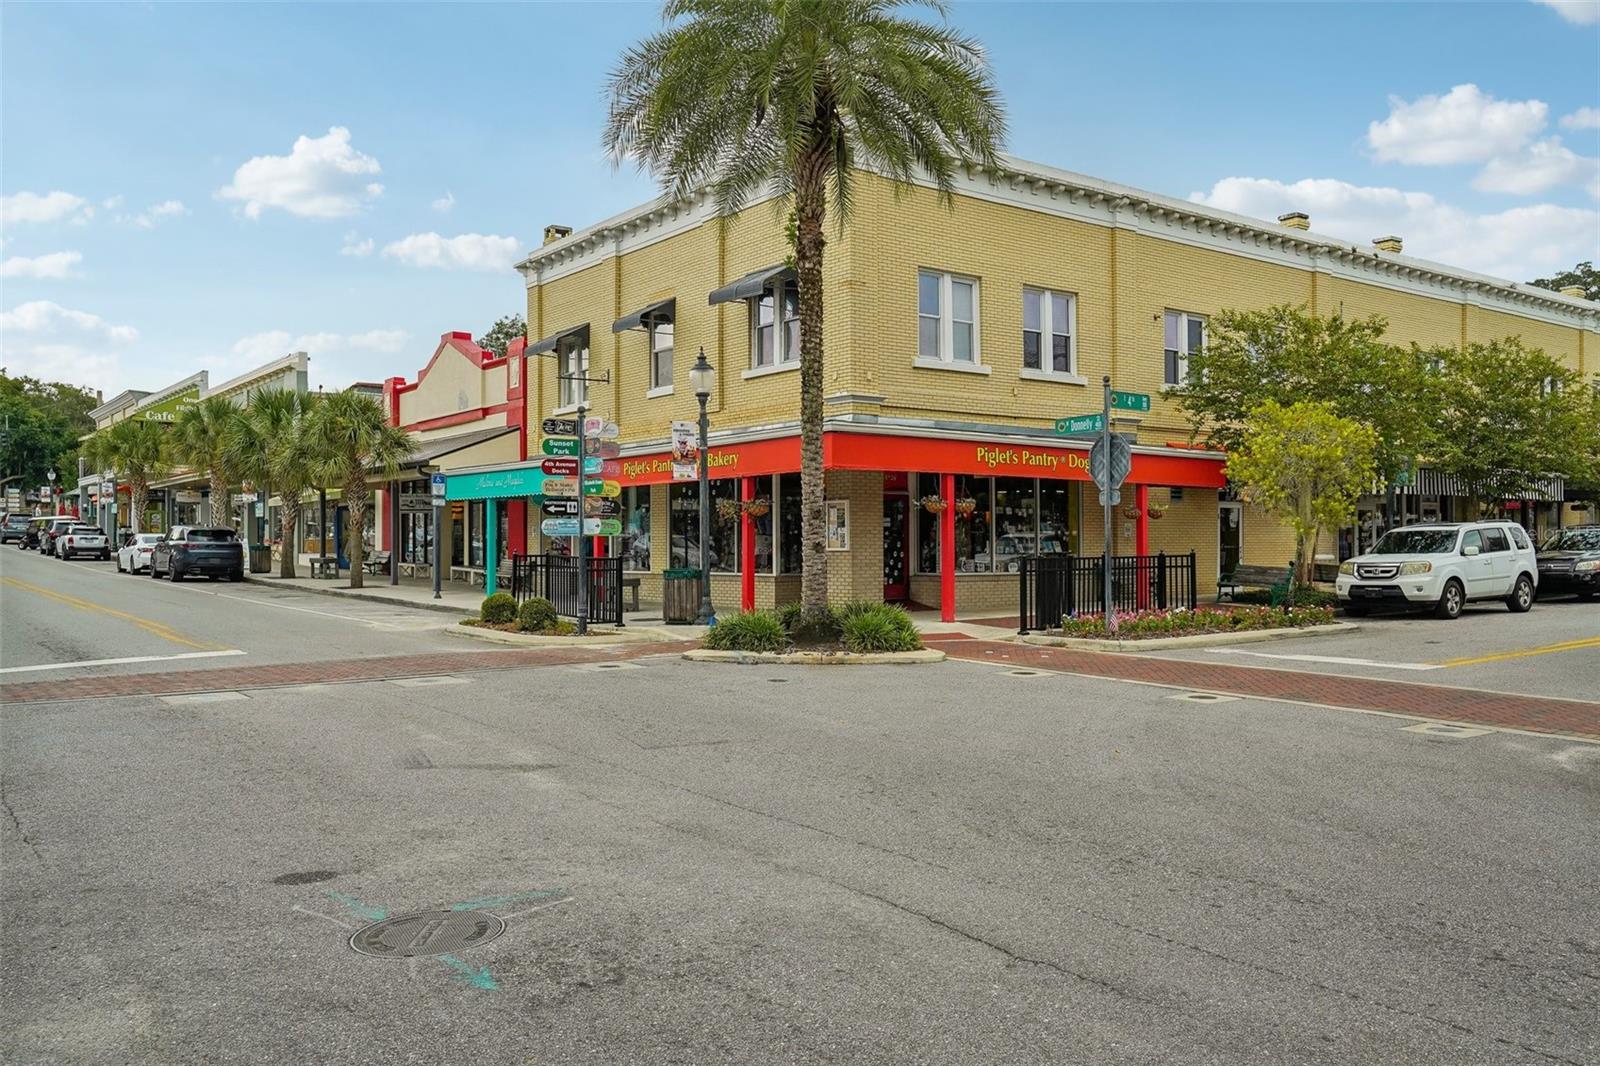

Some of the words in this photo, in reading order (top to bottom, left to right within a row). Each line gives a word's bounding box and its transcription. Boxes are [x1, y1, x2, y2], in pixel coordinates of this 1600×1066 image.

[623, 462, 651, 479] Piglet's
[652, 459, 673, 473] Pantr
[707, 451, 739, 469] Bakery
[977, 447, 1019, 468] Piglet's
[1022, 450, 1059, 471] Pantry
[1068, 453, 1090, 473] Dog
